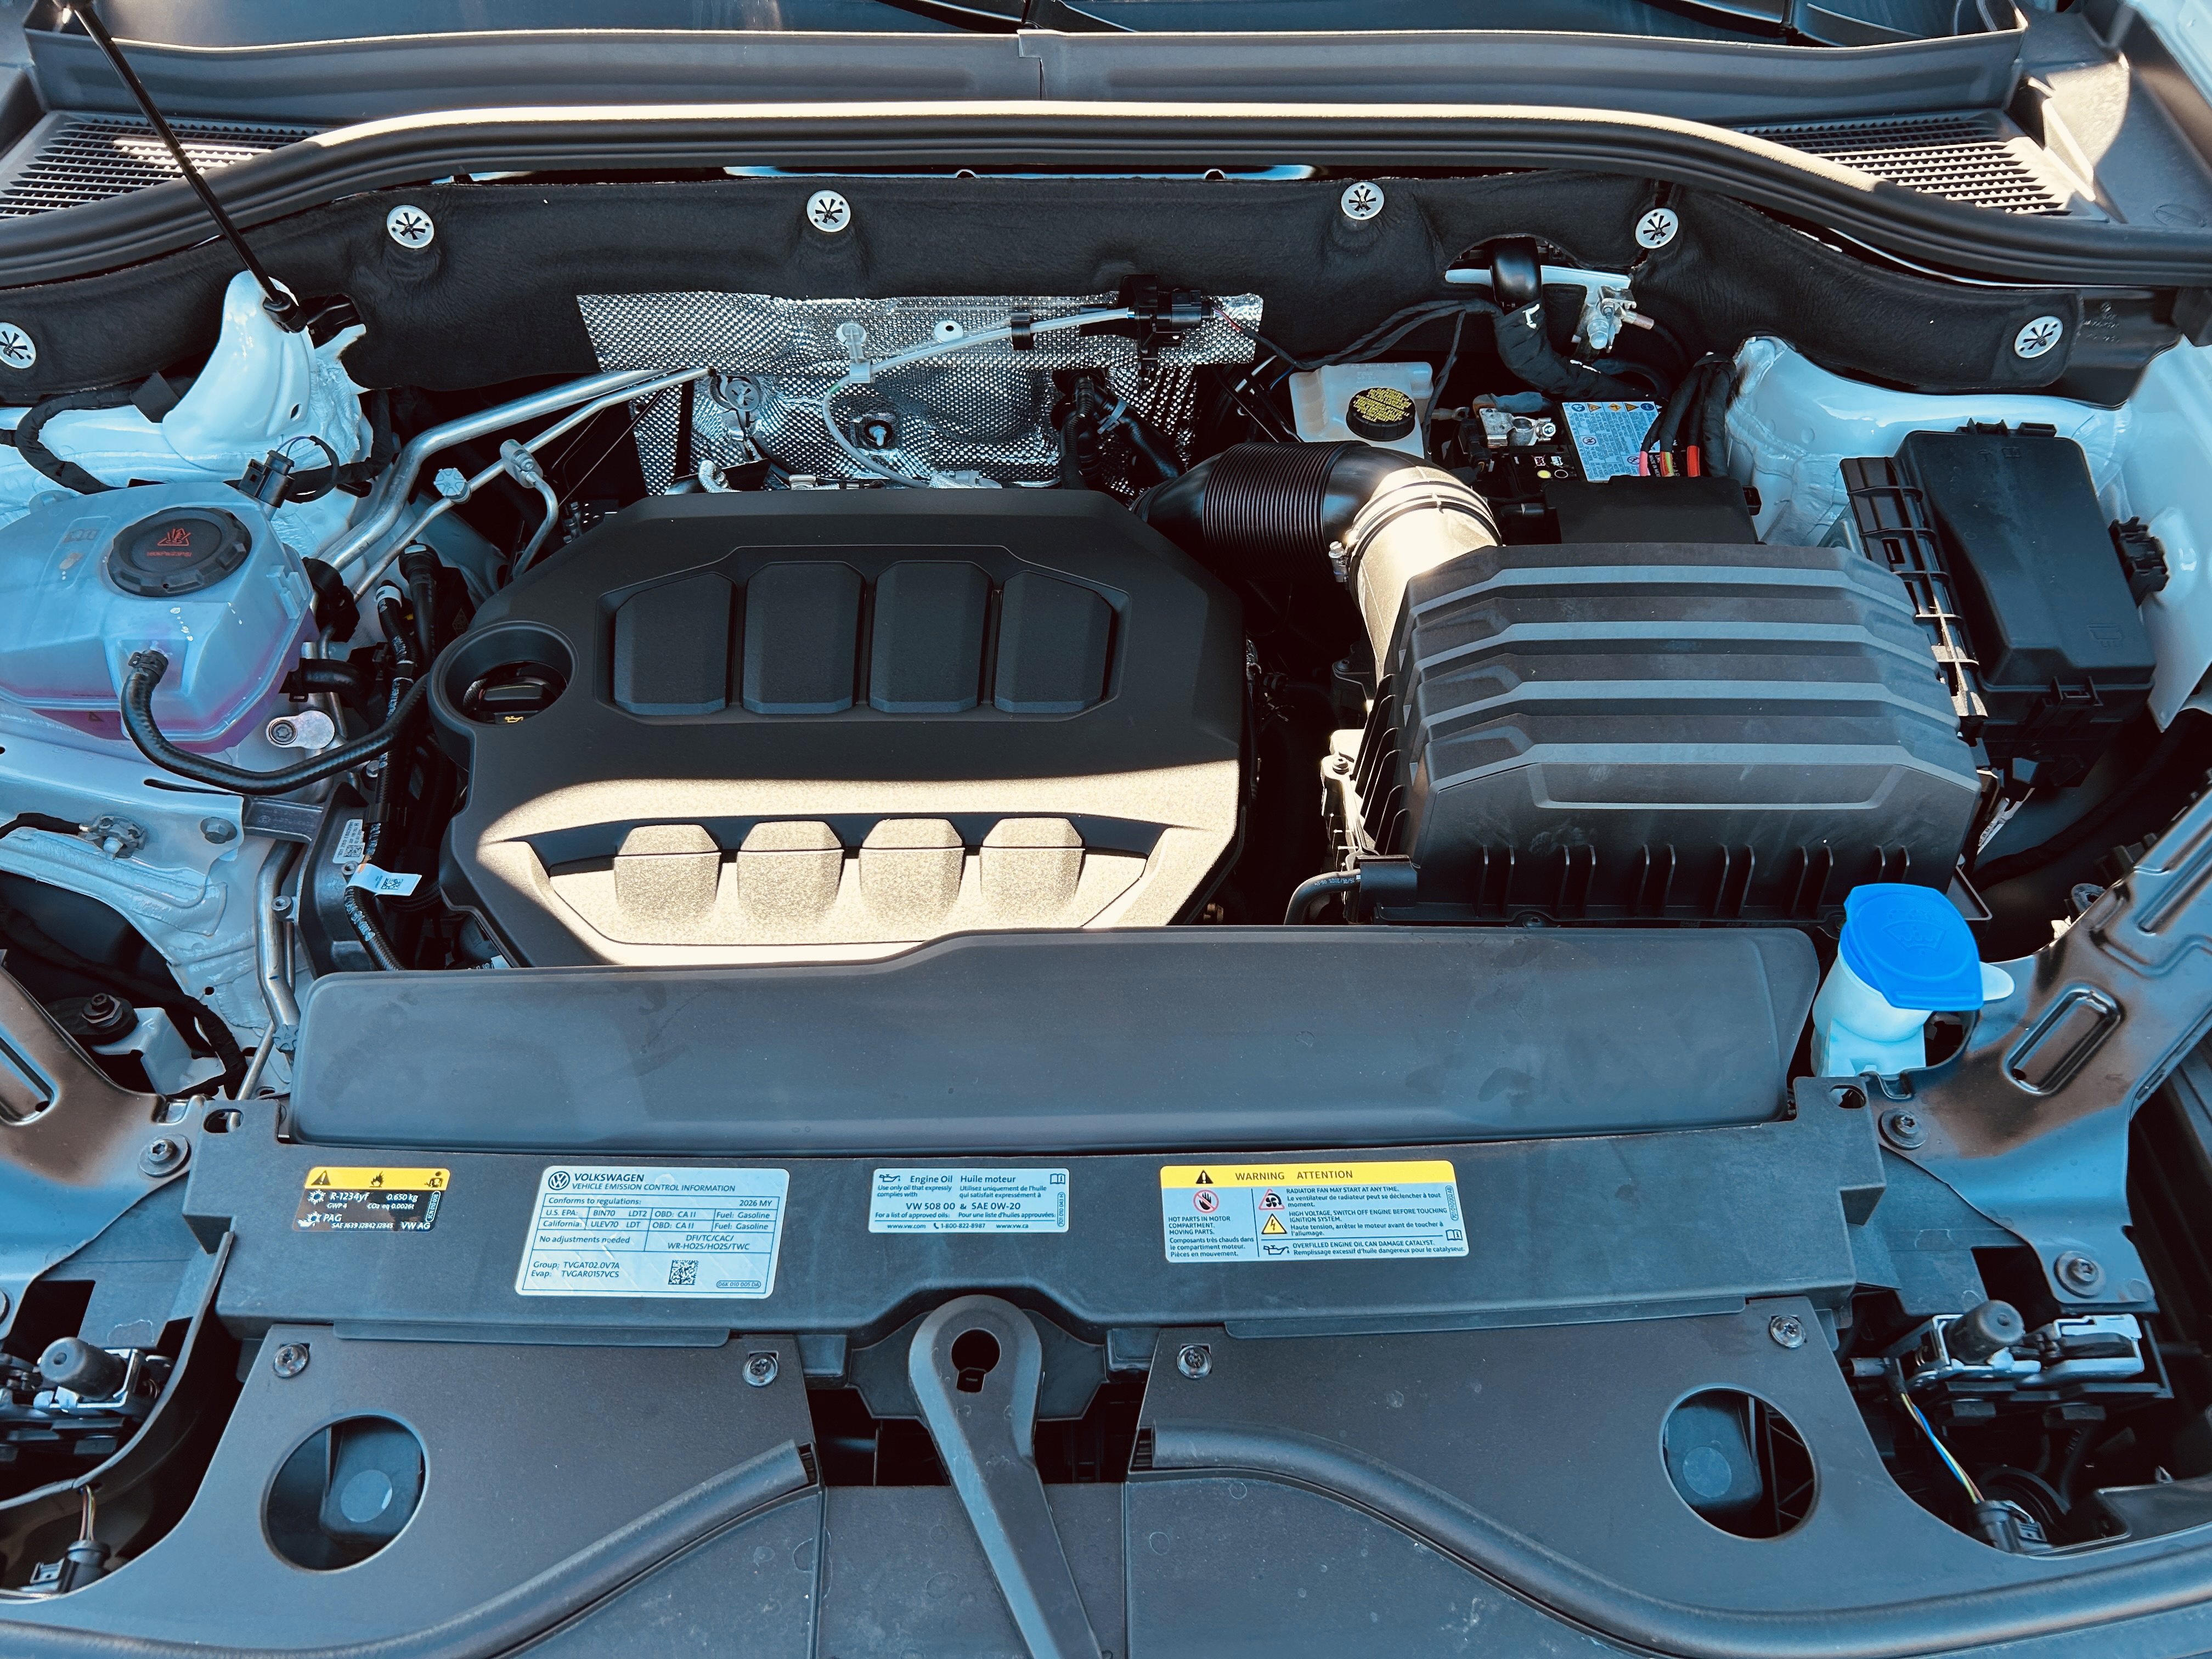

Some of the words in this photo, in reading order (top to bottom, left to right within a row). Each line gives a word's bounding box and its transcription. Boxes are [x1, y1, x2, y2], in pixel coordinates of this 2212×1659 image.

[574, 1173, 645, 1182] VOLKSWAGEN
[1235, 1172, 1285, 1180] WARNING
[1297, 1170, 1353, 1180] ATTENTION
[910, 1176, 939, 1184] Engine
[330, 1192, 370, 1202] R-1234yf
[409, 1193, 419, 1203] kg
[596, 1198, 641, 1206] regulations:
[323, 1214, 343, 1222] PAG
[552, 1235, 600, 1244] adjustments
[533, 1261, 560, 1269] Group:
[531, 1269, 551, 1278] Evap:
